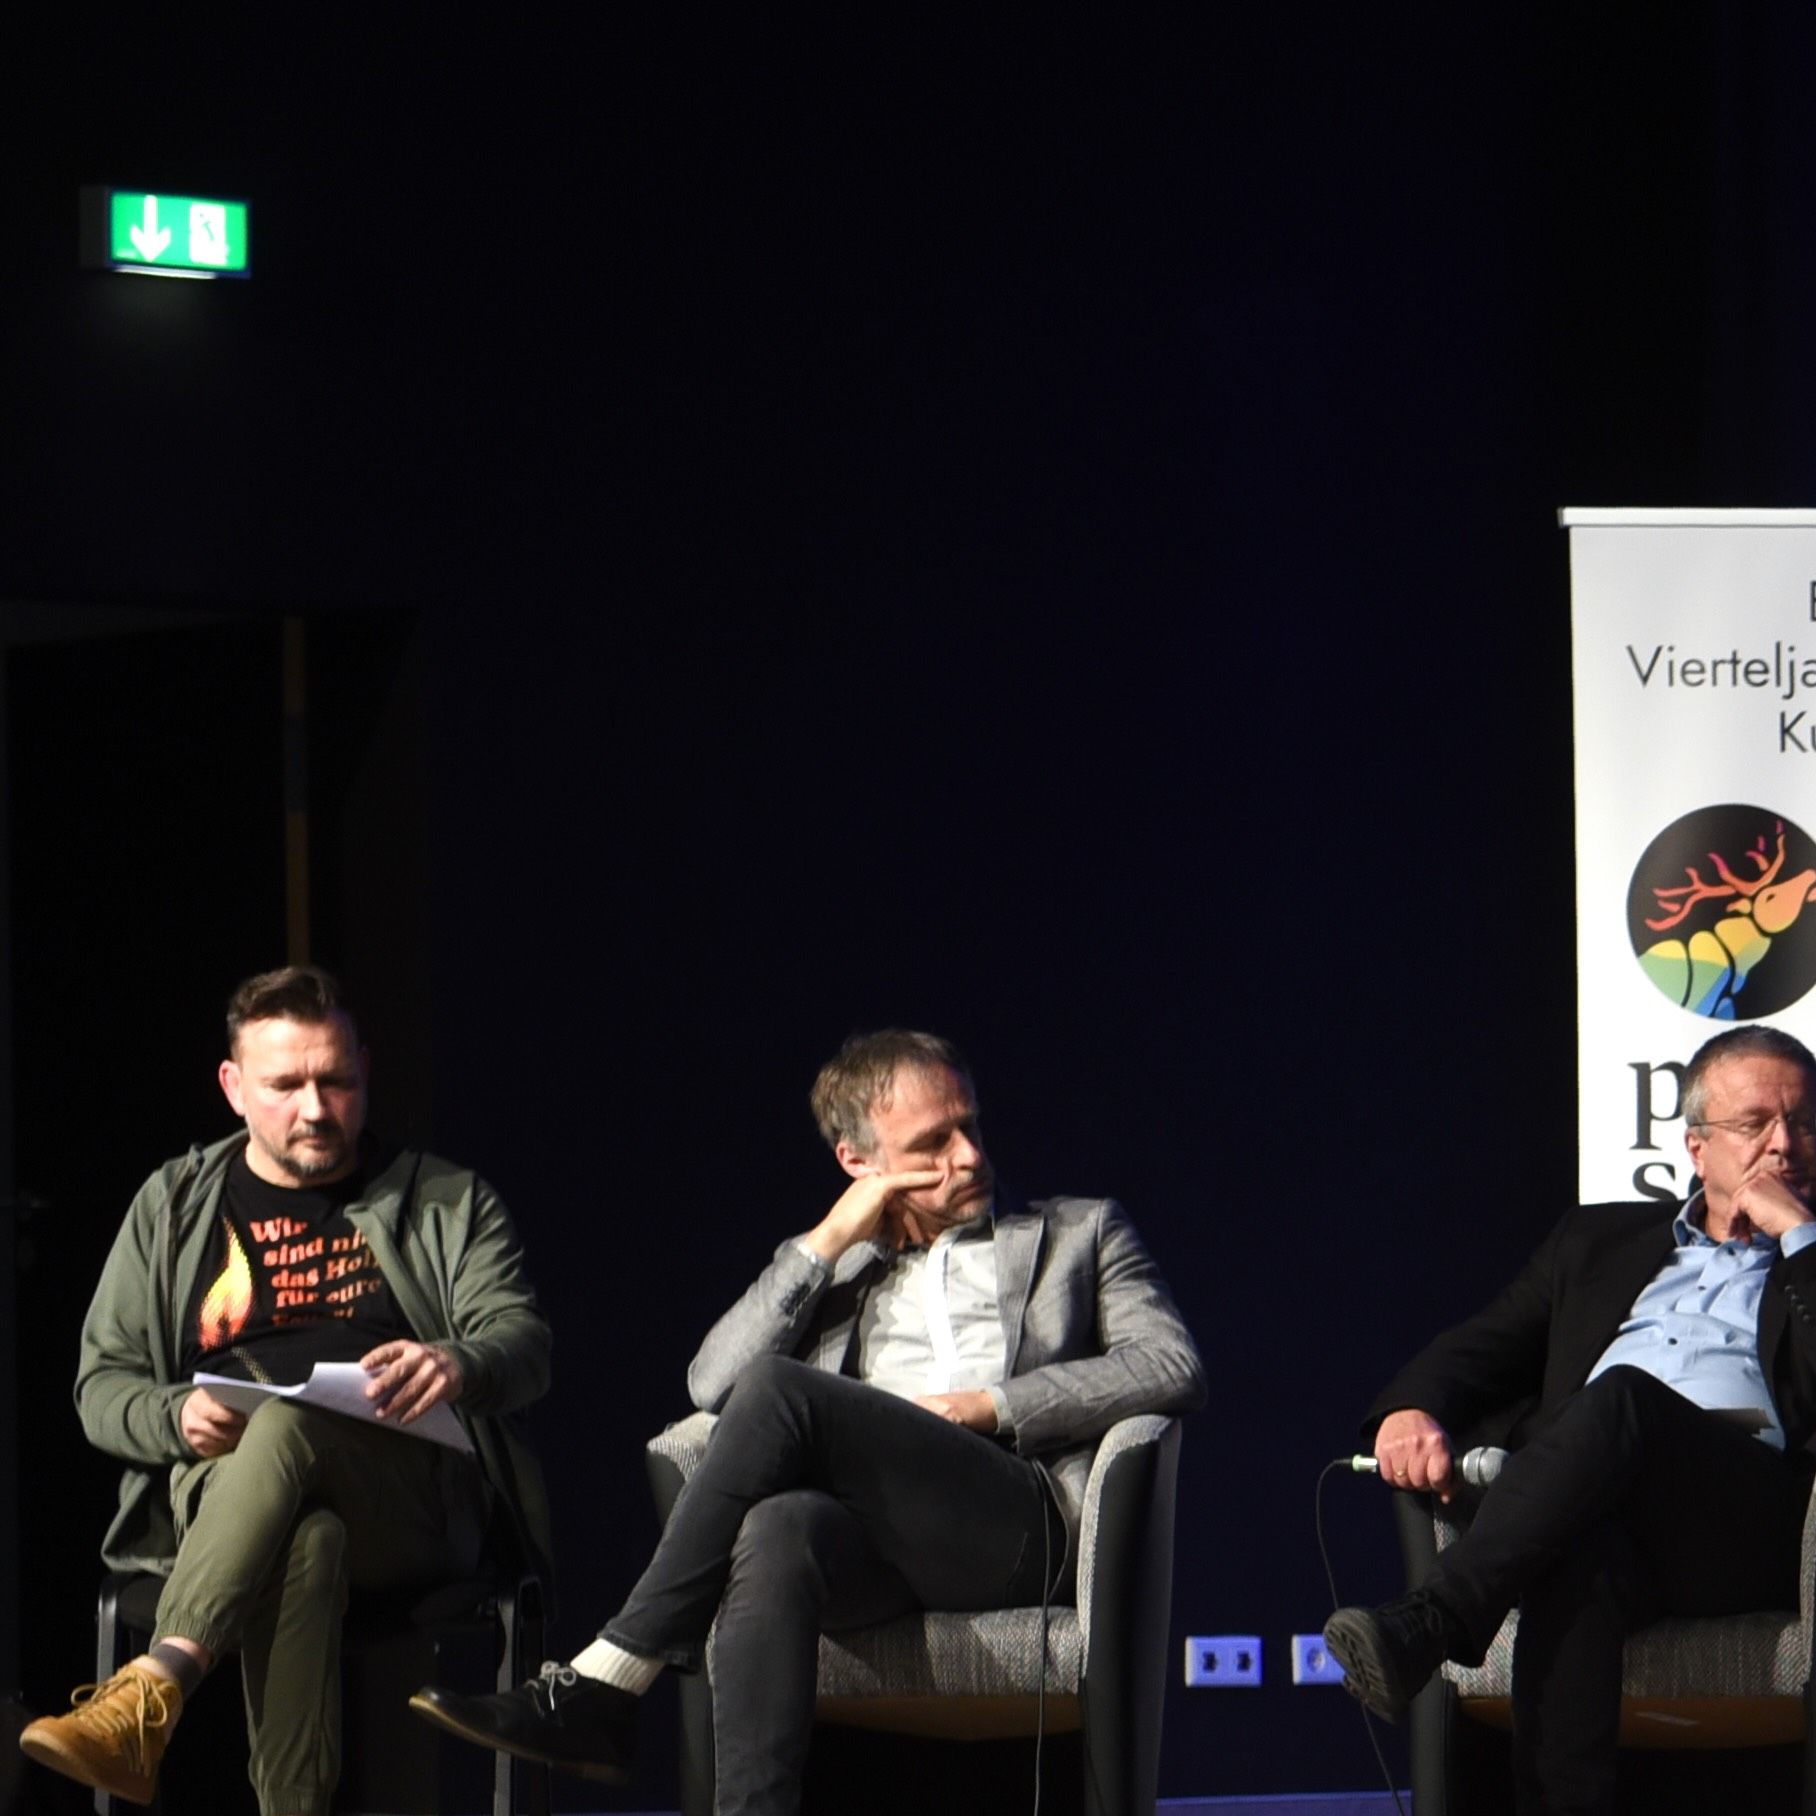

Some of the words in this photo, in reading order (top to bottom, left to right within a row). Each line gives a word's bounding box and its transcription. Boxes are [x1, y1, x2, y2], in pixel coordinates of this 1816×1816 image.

[249, 1216, 308, 1243] Wir
[263, 1236, 324, 1267] sind
[271, 1267, 320, 1288] das
